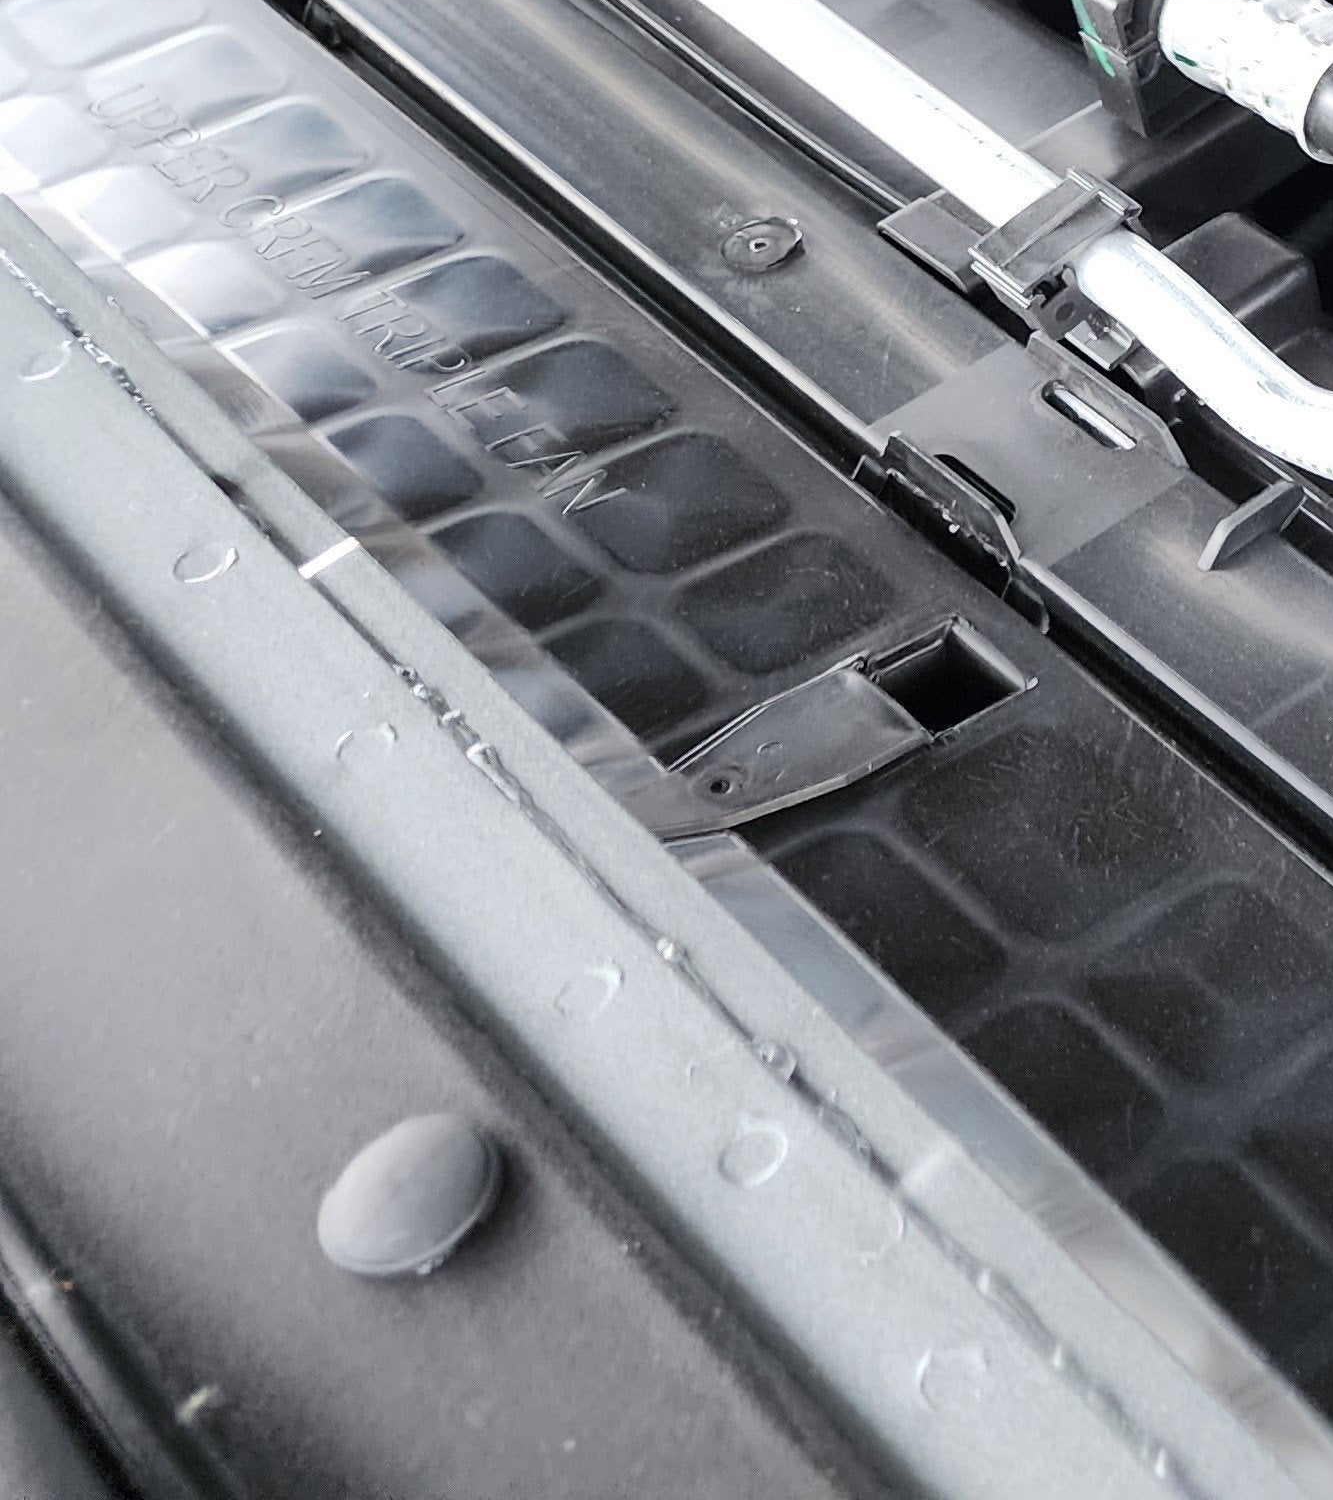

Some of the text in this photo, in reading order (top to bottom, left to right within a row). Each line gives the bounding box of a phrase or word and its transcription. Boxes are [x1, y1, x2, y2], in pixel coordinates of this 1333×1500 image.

[87, 82, 629, 517] UPPER CRFM TRIPLE FAN
